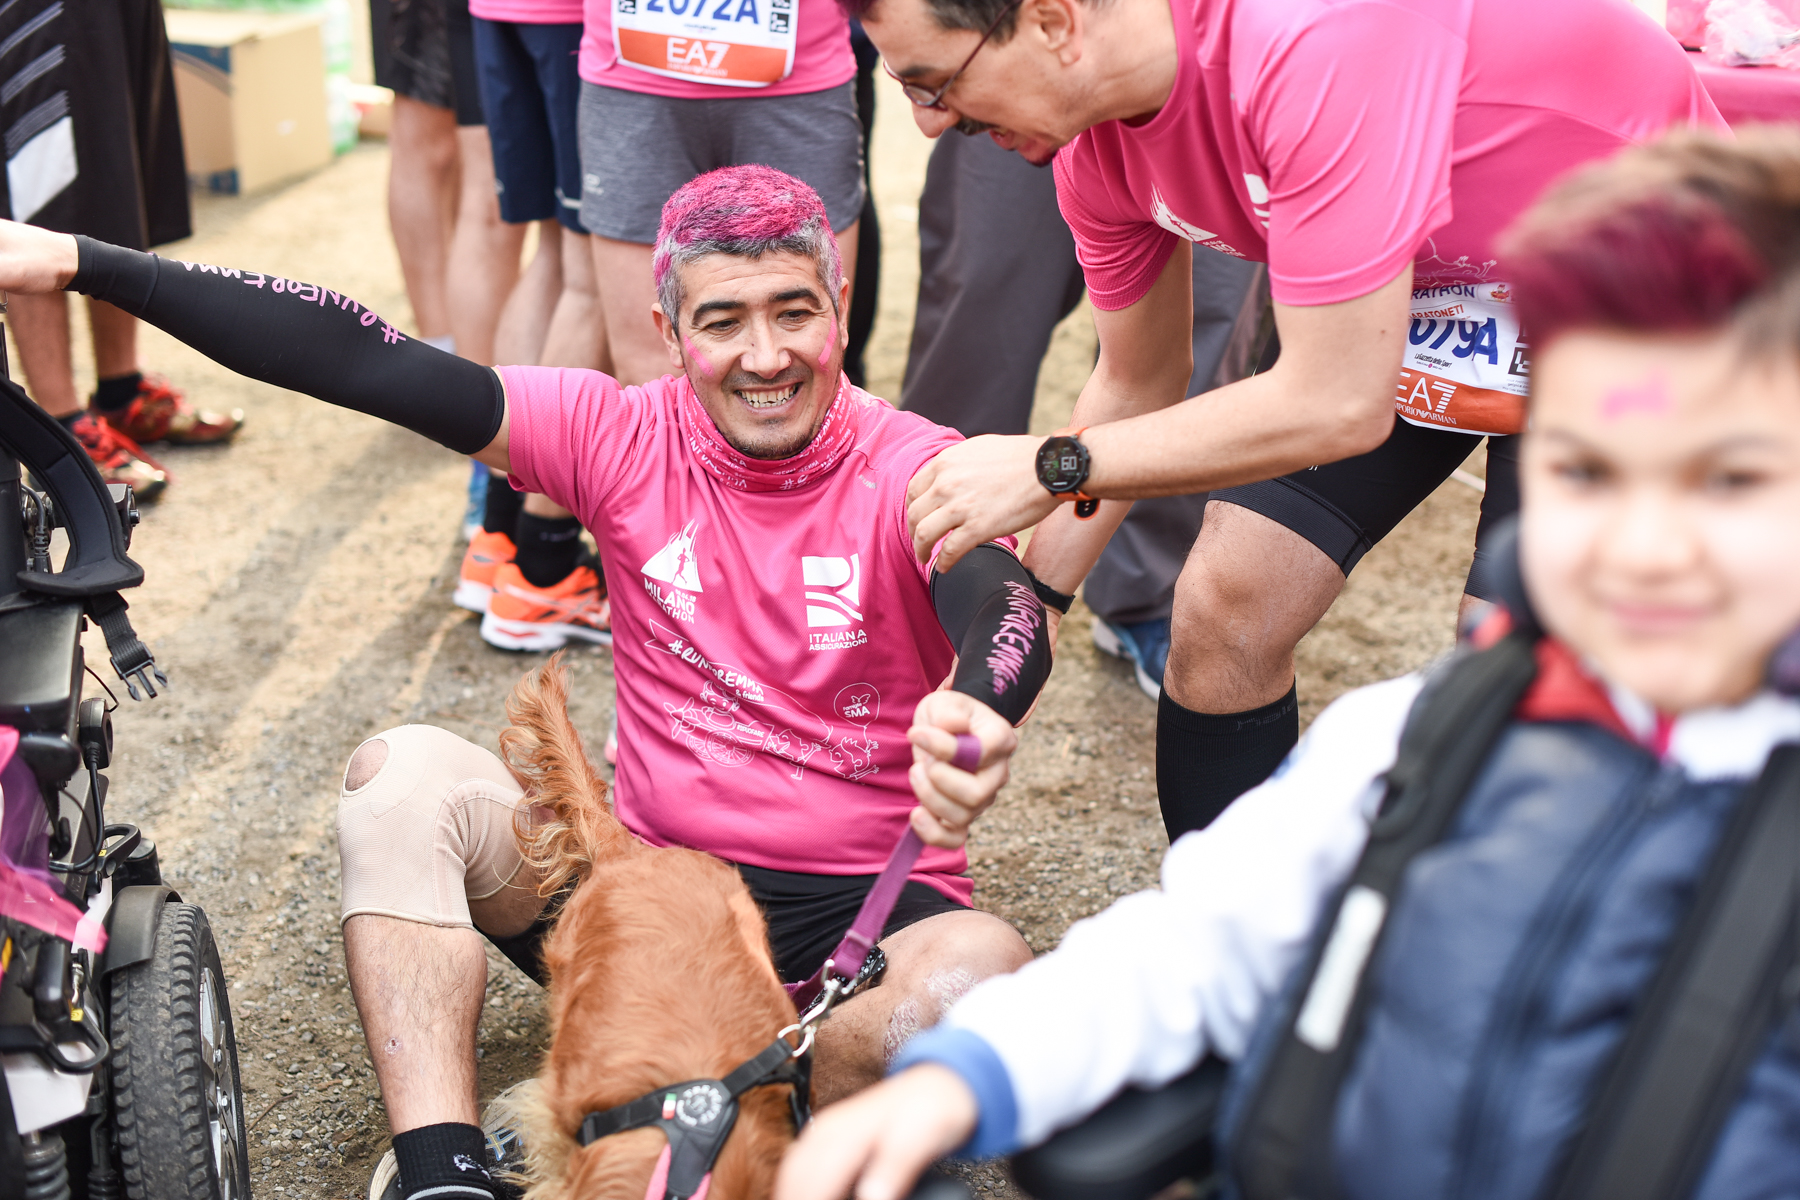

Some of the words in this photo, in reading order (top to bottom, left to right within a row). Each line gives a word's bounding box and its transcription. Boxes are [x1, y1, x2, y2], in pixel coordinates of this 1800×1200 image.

[667, 37, 731, 69] EA7
[1061, 456, 1077, 471] 60
[643, 577, 695, 616] MILANO
[809, 628, 867, 644] ITALIANA
[808, 637, 868, 651] ASSICURAZIONI
[844, 705, 871, 718] SMA
